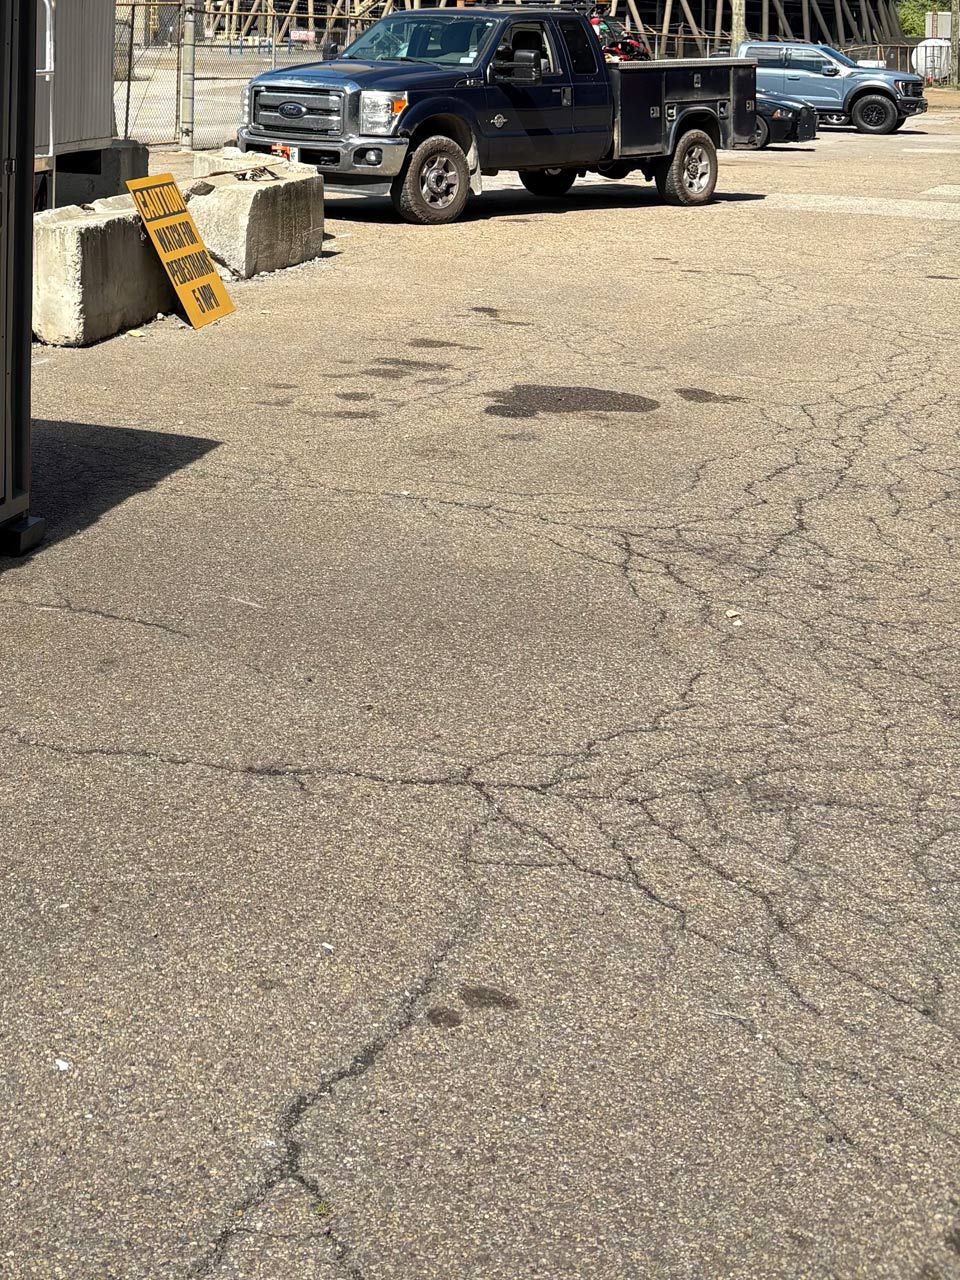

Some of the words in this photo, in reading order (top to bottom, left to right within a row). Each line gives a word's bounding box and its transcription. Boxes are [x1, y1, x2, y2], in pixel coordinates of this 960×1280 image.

[134, 184, 185, 219] CAUTION
[154, 223, 187, 253] WATCH
[178, 220, 198, 246] FOR
[166, 250, 214, 286] PEDESTRIANS
[191, 288, 205, 313] 5
[197, 283, 220, 311] MPH
